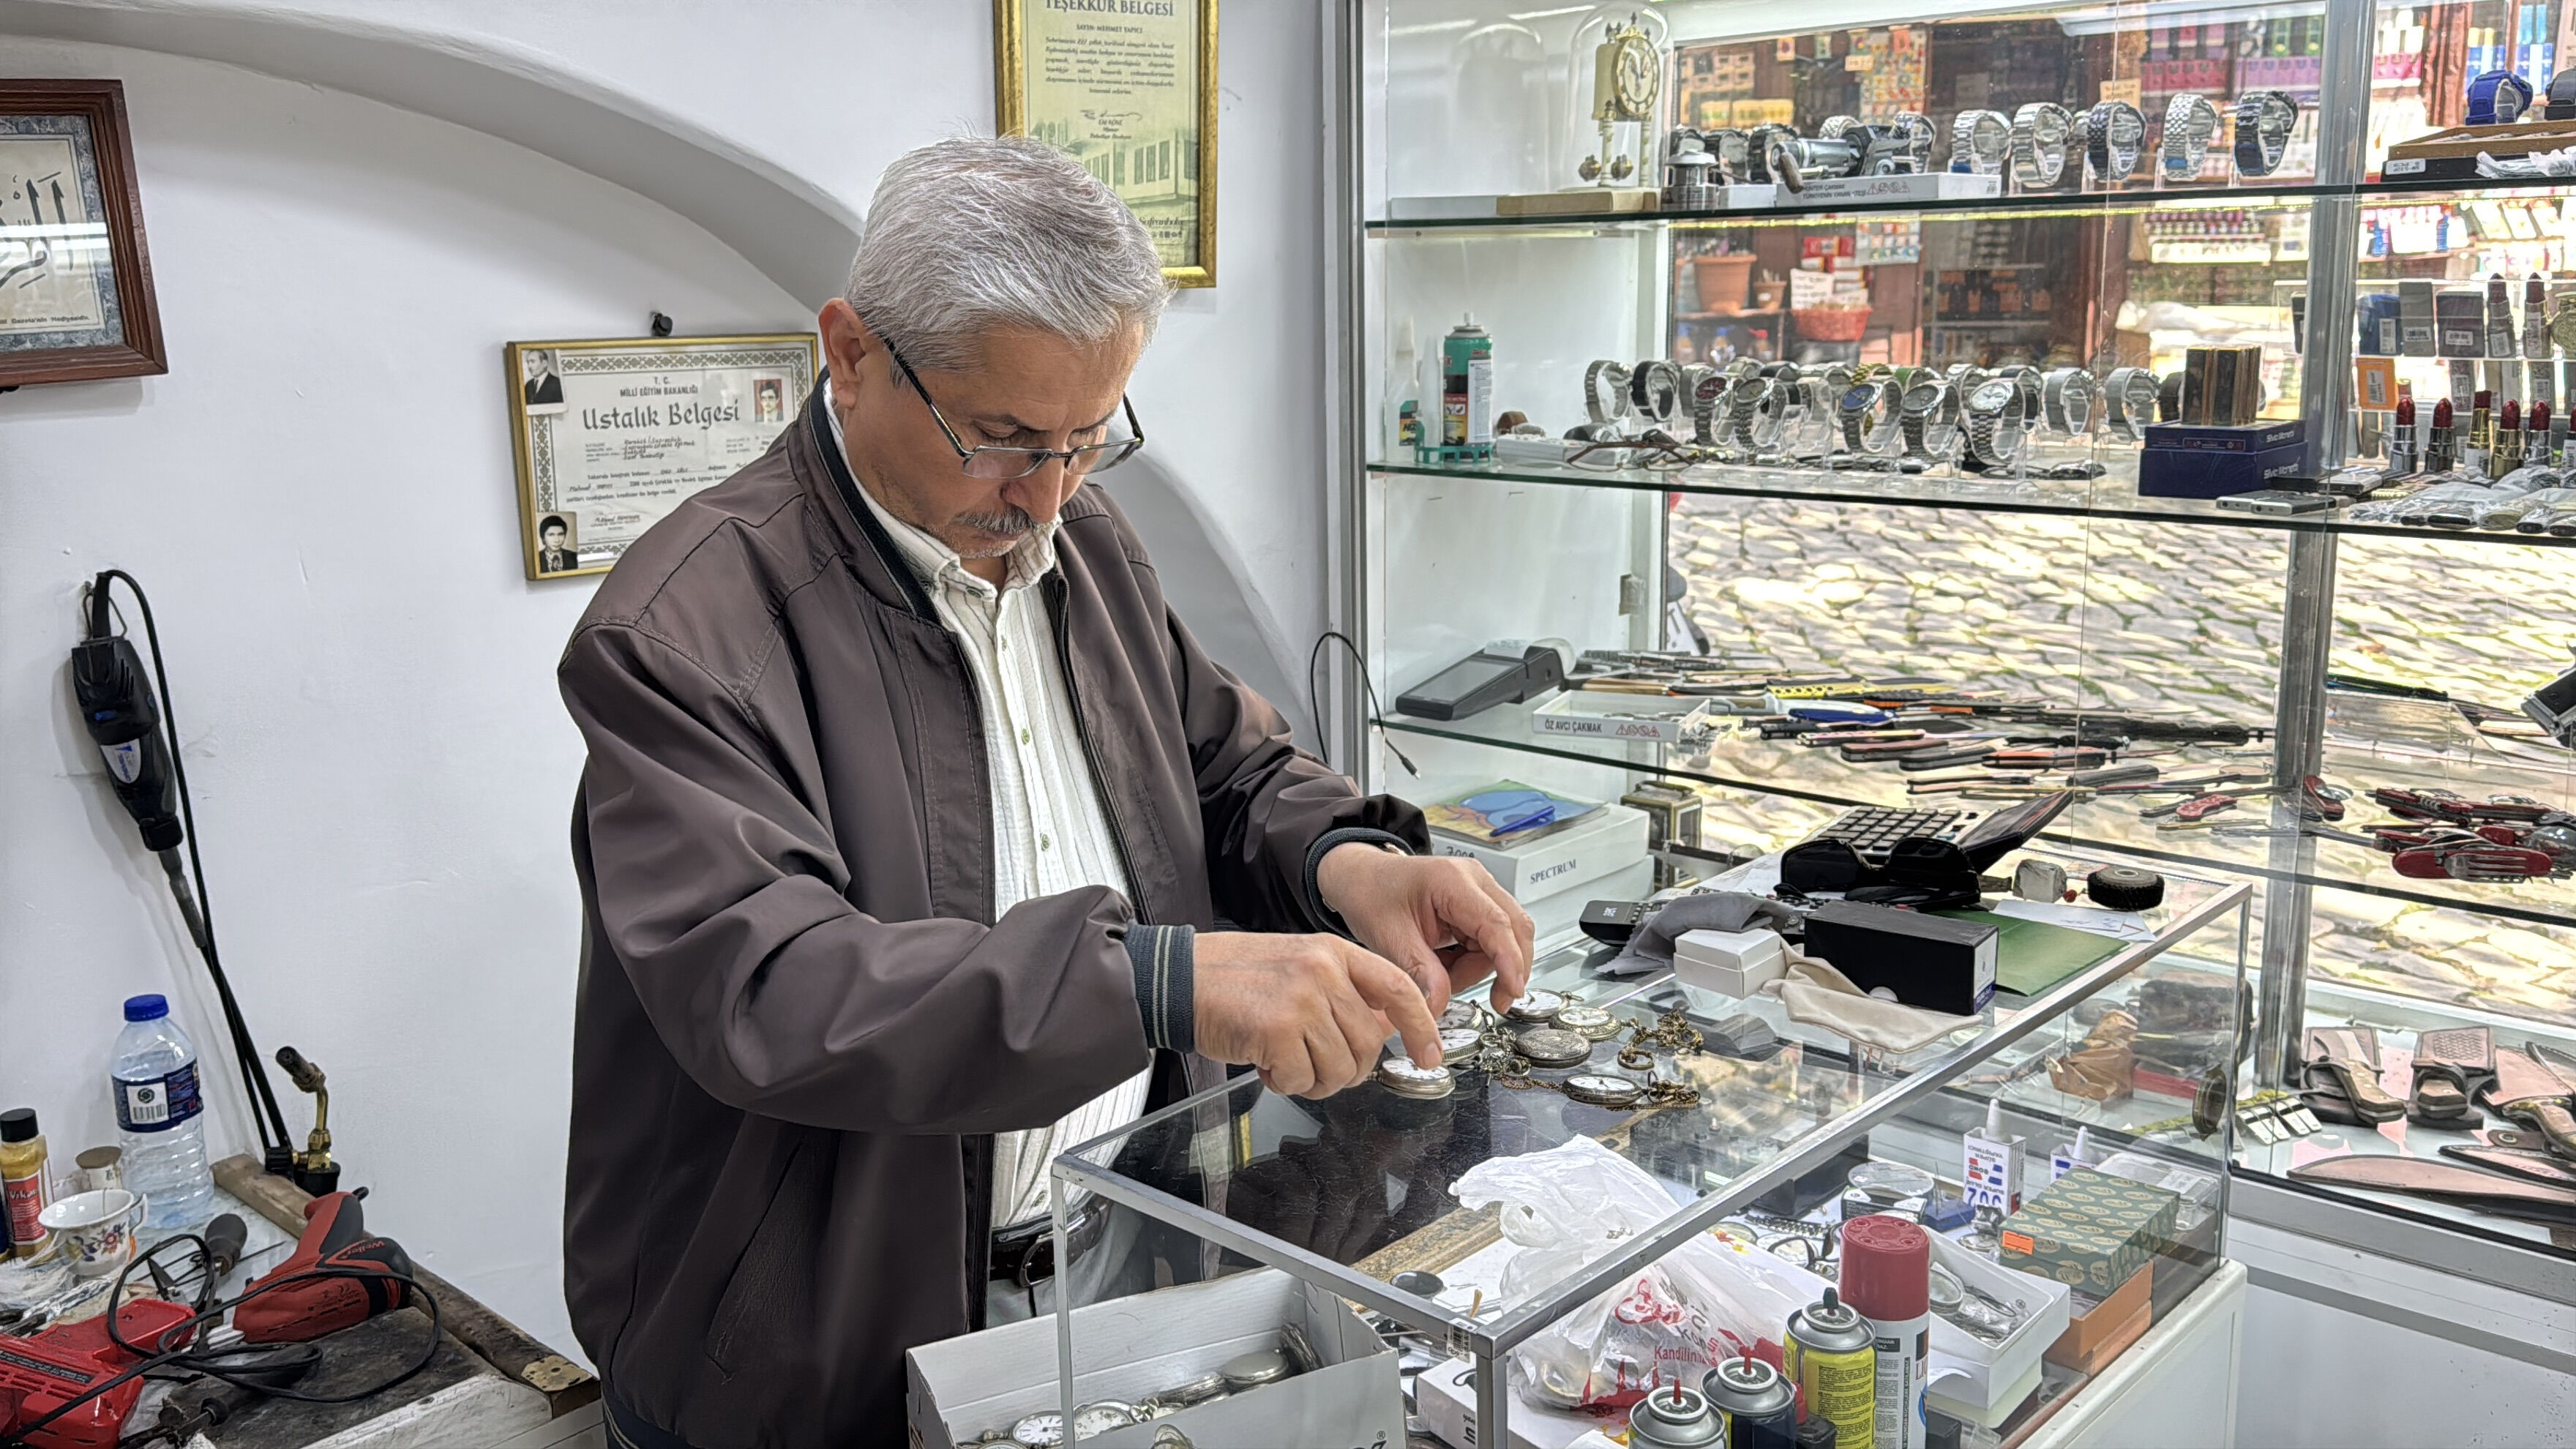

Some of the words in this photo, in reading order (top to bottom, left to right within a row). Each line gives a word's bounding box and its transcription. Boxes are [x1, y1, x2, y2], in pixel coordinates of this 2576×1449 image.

[620, 387, 638, 397] MİLLİ
[640, 386, 662, 397] EĞİTİM
[664, 383, 698, 395] BAKANLIĞI
[583, 405, 660, 430] Ustalık
[669, 399, 740, 430] Belgesi
[1545, 719, 1554, 730] ÖZ
[1555, 721, 1570, 730] AVCI
[1573, 722, 1603, 733] ÇAKMAK
[1530, 859, 1577, 884] SPECTRUM
